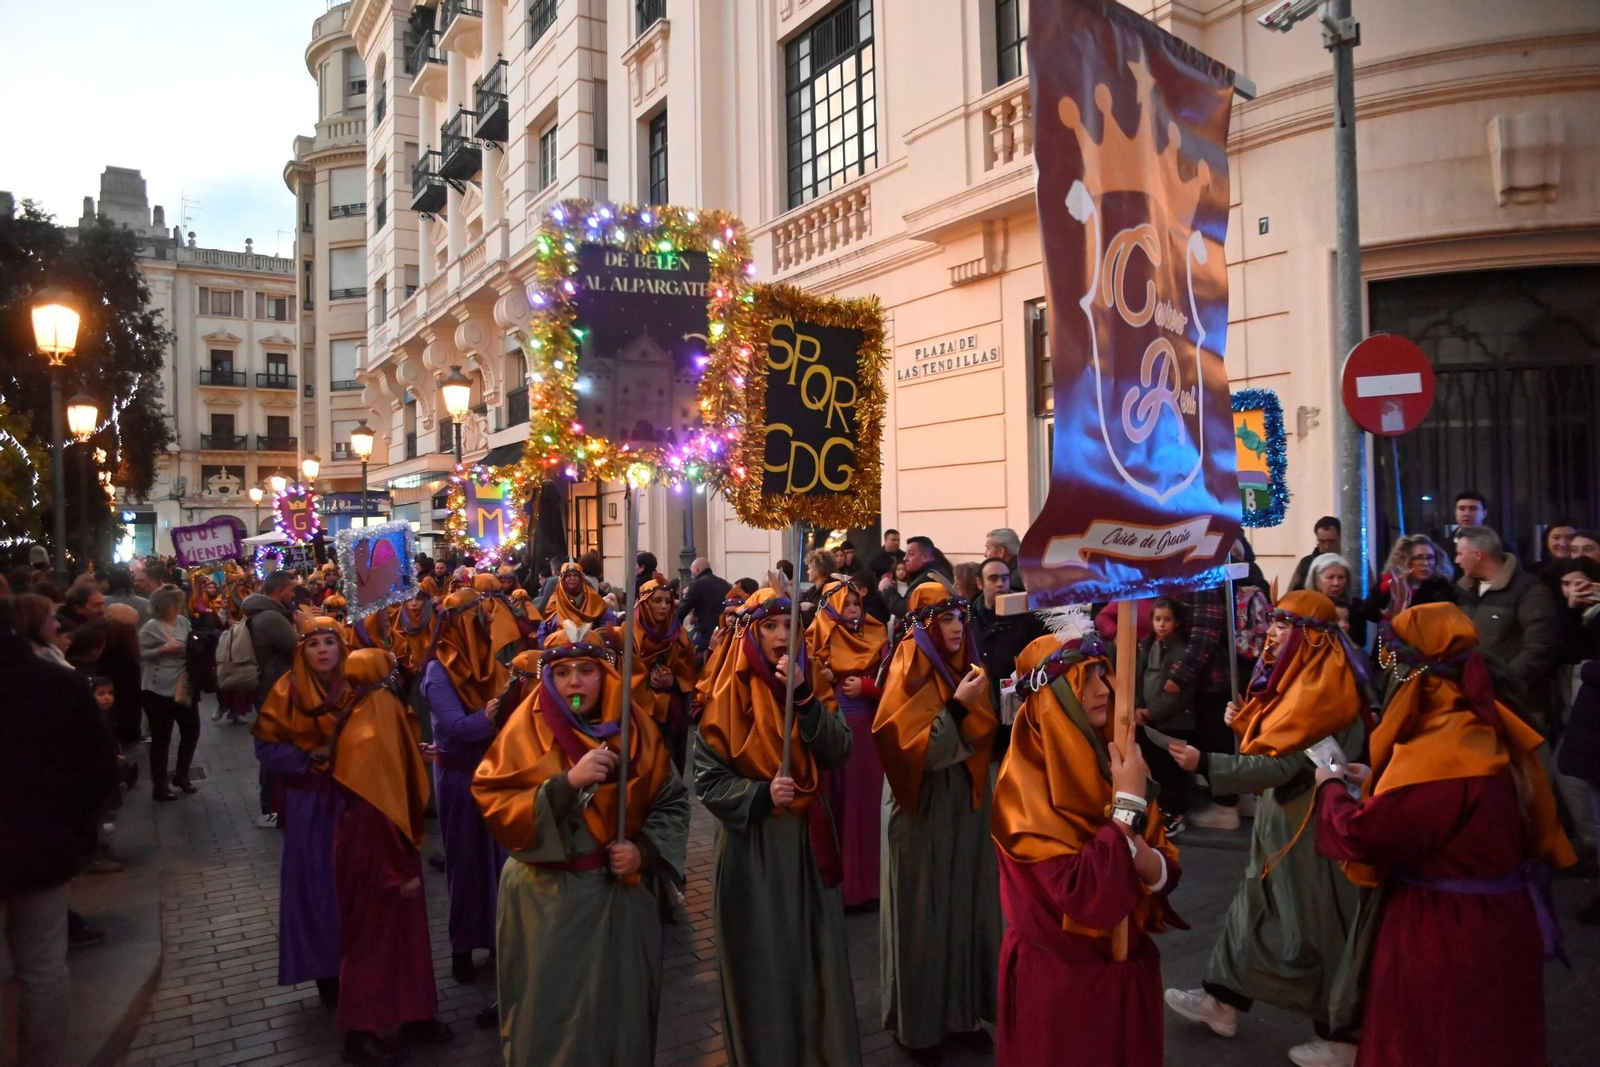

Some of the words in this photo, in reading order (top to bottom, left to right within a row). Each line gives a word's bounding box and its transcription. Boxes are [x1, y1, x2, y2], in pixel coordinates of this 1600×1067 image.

[1260, 218, 1268, 233] 7
[604, 251, 629, 268] DE
[582, 275, 606, 292] AL
[914, 341, 955, 360] PLAZA
[959, 336, 976, 350] DE
[897, 365, 919, 380] LAS
[922, 348, 998, 375] TENDILLAS
[293, 512, 307, 530] G
[478, 507, 504, 539] M
[1139, 533, 1157, 549] de
[1154, 528, 1192, 555] Gracia
